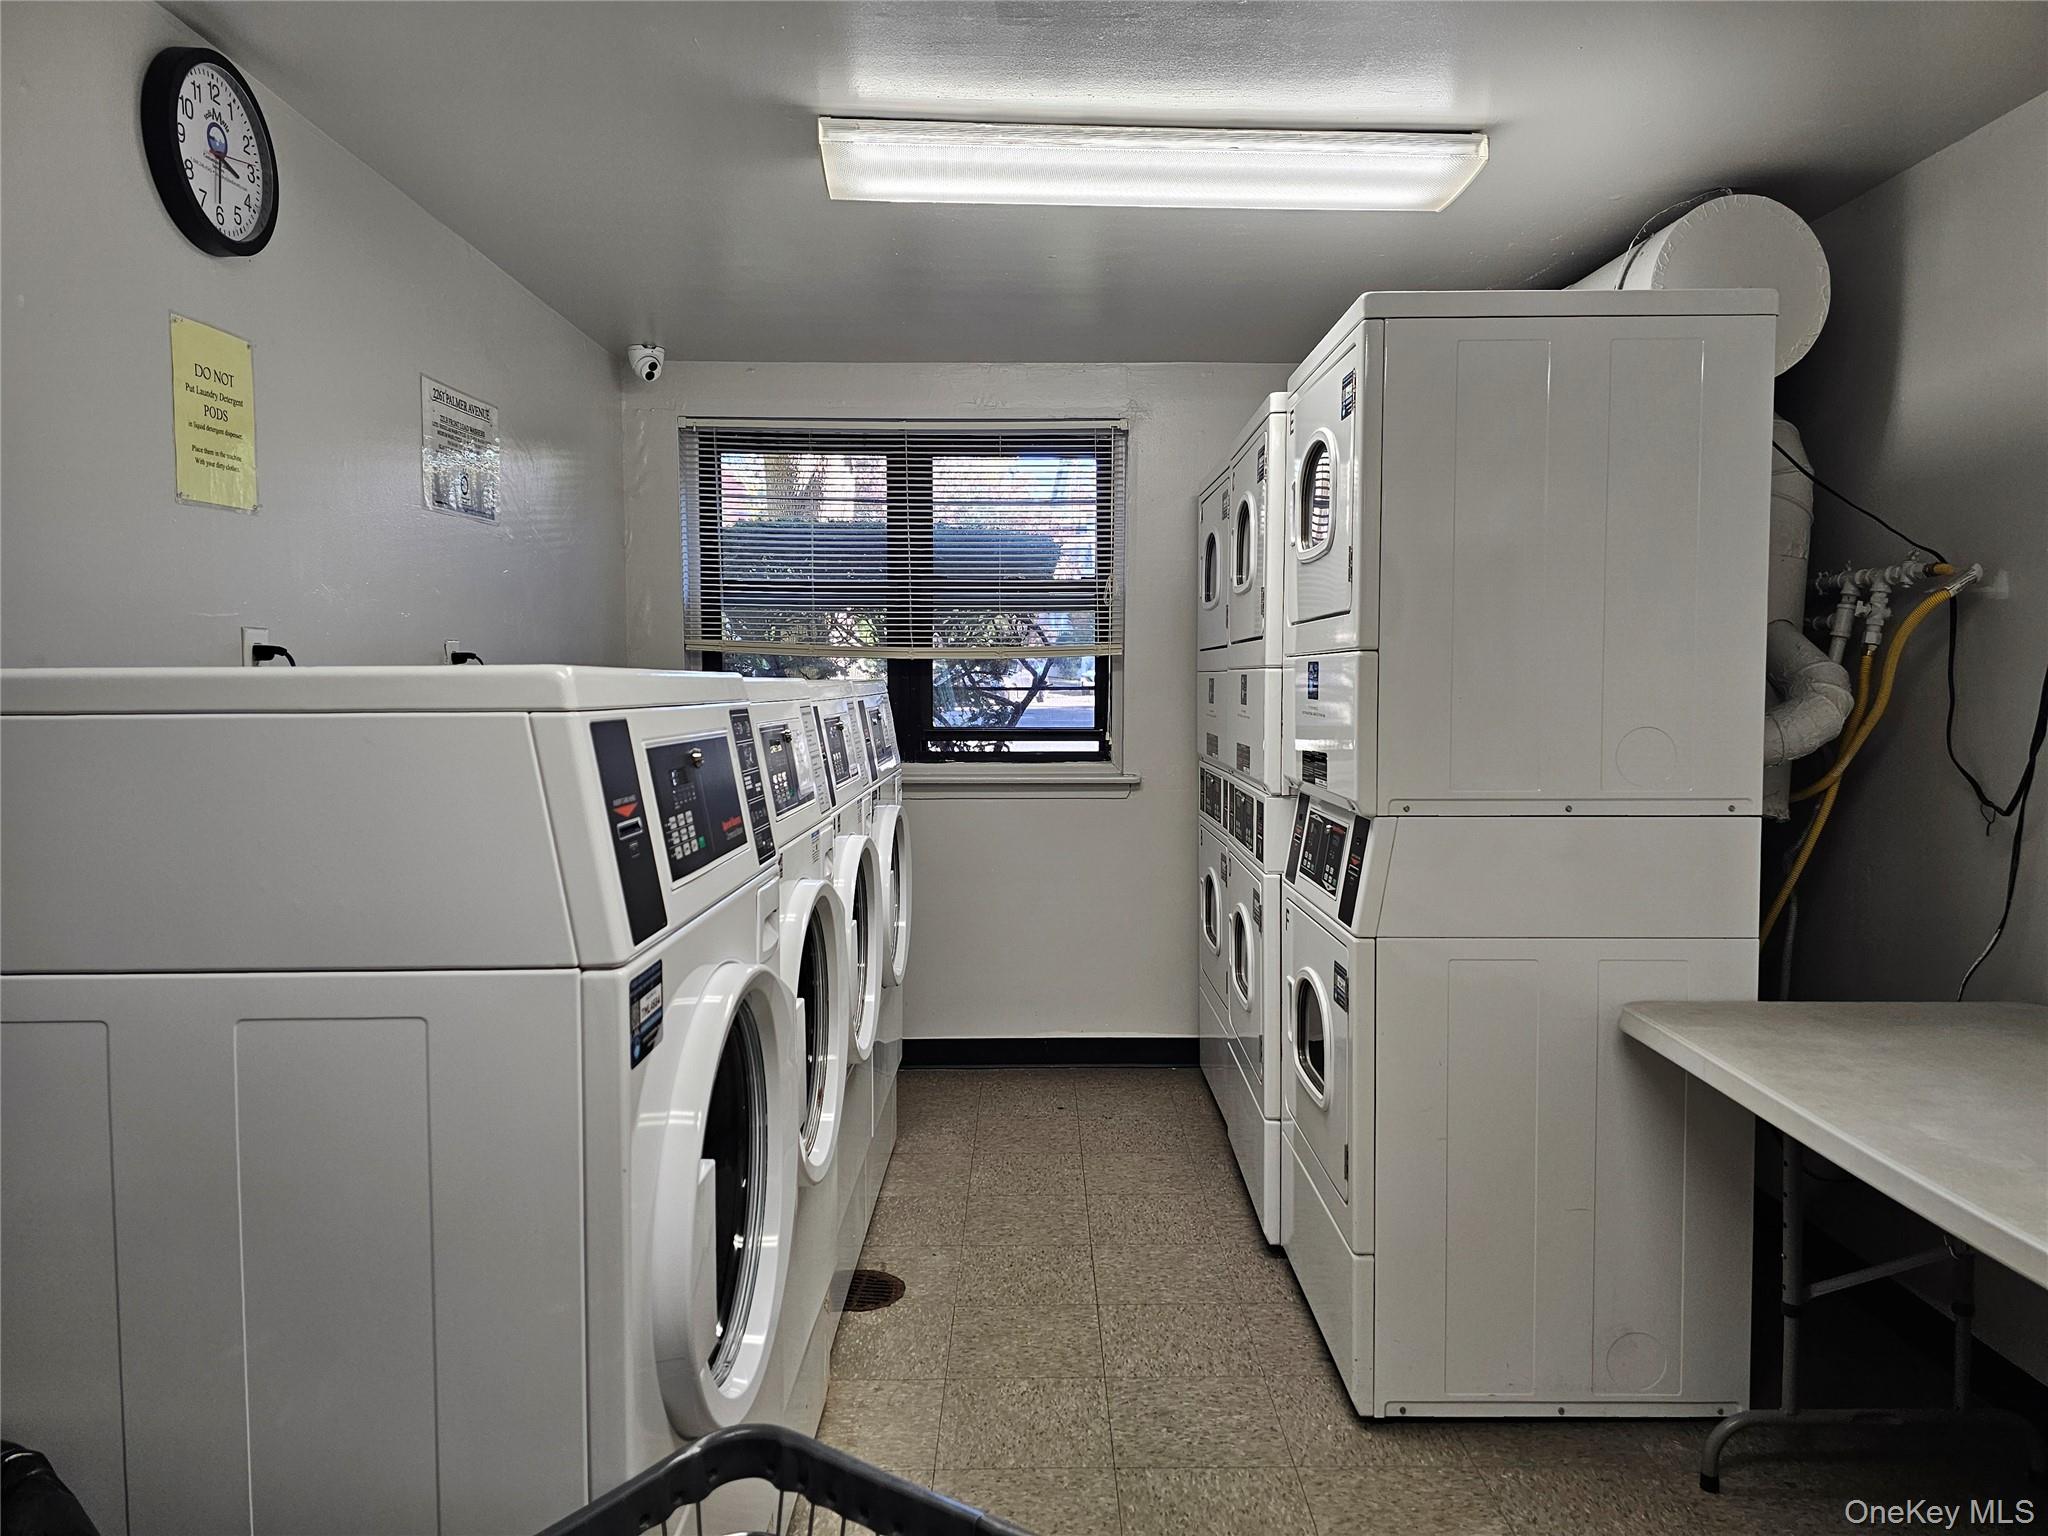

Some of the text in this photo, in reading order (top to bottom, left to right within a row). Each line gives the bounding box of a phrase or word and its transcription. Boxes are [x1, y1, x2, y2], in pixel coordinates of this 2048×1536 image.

[191, 80, 202, 103] 11
[207, 81, 221, 105] 12
[178, 95, 194, 120] 10
[227, 103, 233, 121] 1
[177, 122, 186, 143] 9
[243, 135, 251, 156] 2
[184, 158, 194, 180] 8
[247, 164, 256, 184] 3
[199, 188, 208, 207] 7
[243, 193, 253, 212] 4
[215, 205, 225, 226] 6
[233, 205, 243, 226] 5
[195, 363, 234, 388] DO NOT
[185, 382, 243, 407] Put Laundry Detergent
[204, 404, 229, 422] PODS
[446, 393, 467, 412] PALMER
[468, 404, 490, 420] AVENUE
[194, 456, 206, 466] With
